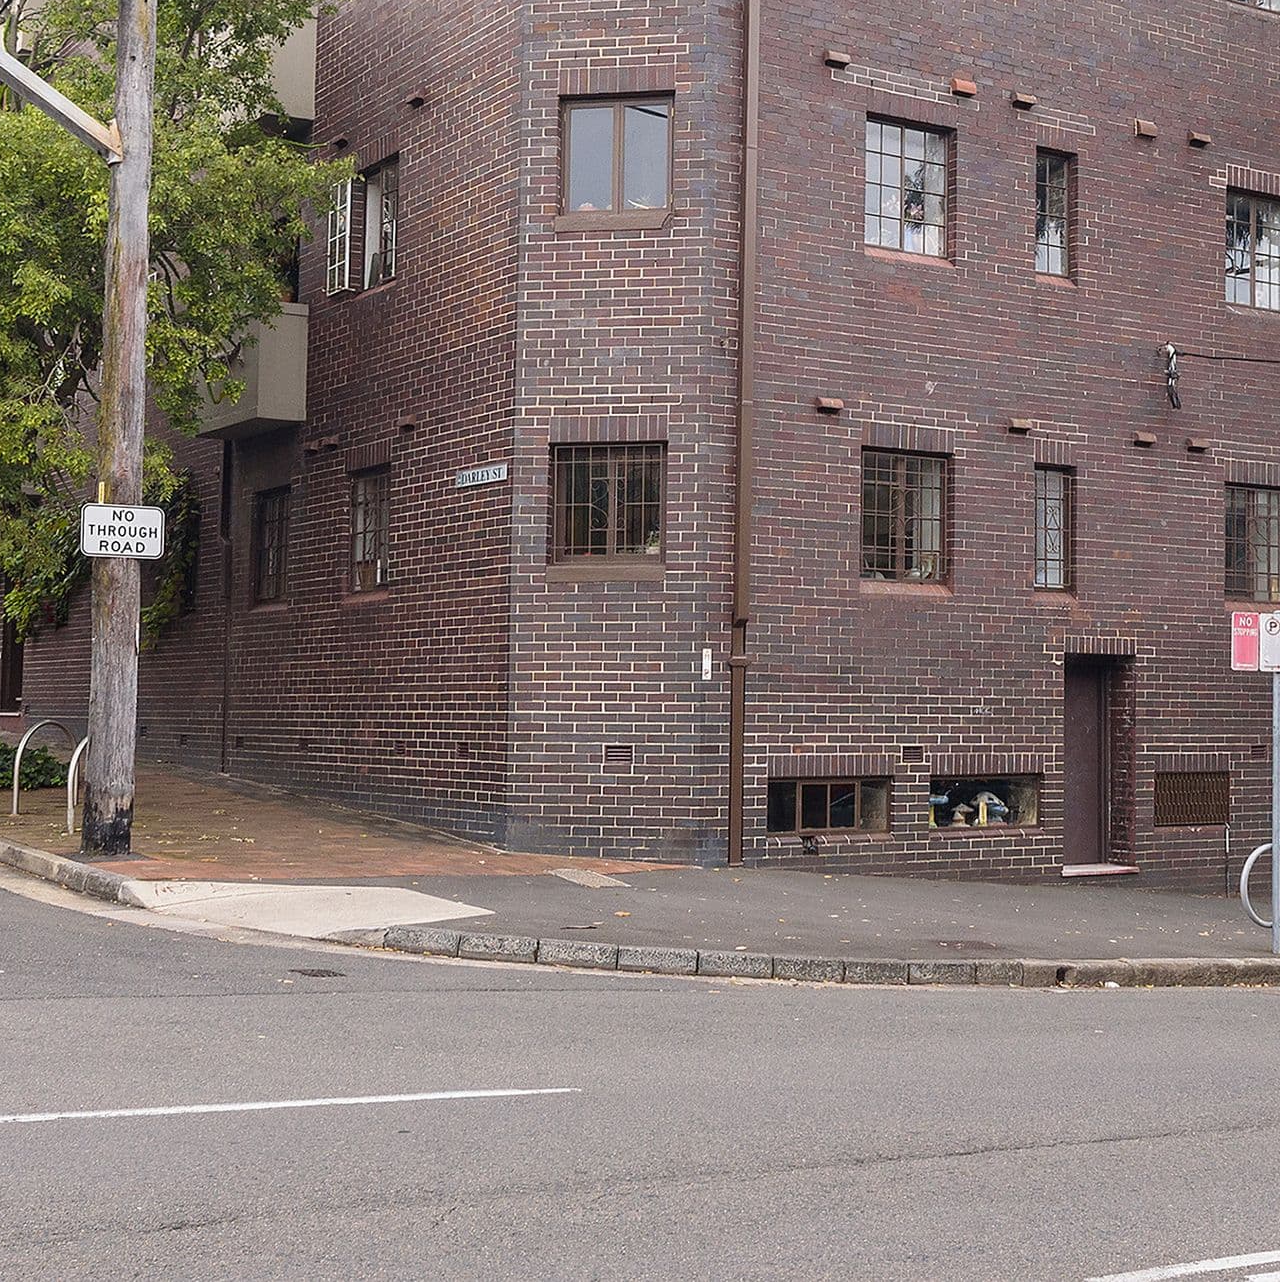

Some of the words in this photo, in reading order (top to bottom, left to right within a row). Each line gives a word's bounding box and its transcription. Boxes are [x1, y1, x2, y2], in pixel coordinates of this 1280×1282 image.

[461, 469, 491, 485] DARLEY
[493, 467, 503, 479] ST
[112, 509, 135, 522] NO
[88, 524, 158, 539] THROUGH
[99, 540, 146, 554] ROAD
[1239, 617, 1253, 627] NO
